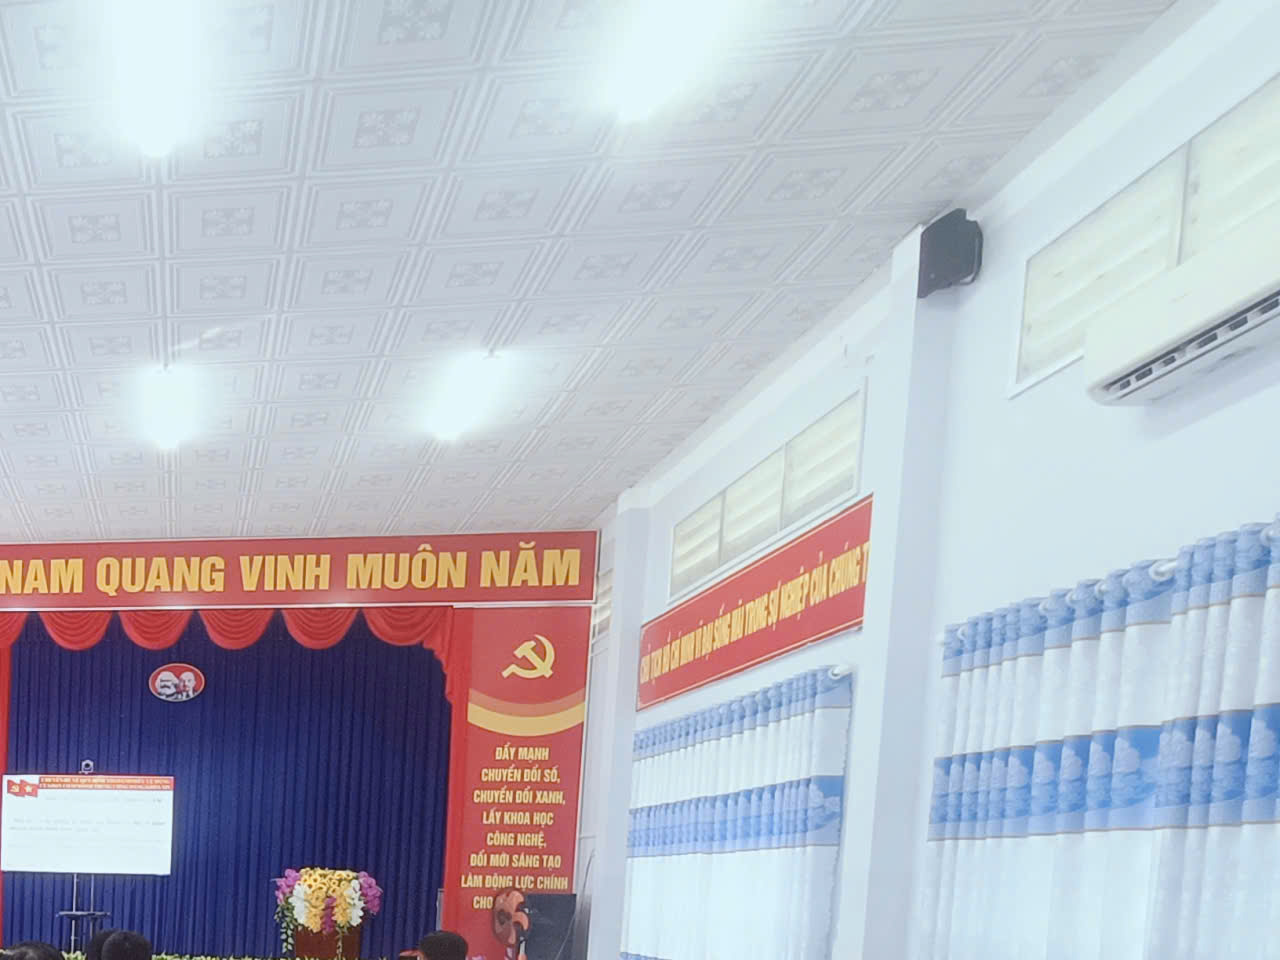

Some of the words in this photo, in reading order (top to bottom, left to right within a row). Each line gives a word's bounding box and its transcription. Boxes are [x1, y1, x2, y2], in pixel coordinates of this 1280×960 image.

[96, 556, 225, 597] QUANG
[239, 554, 330, 592] VINH
[346, 543, 467, 589] MUÔN
[479, 541, 581, 588] NĂM
[809, 551, 829, 606] CỦA
[828, 541, 862, 598] CHÚNG
[517, 746, 550, 764] MẠNH
[481, 763, 522, 782] CHUYỂN
[523, 763, 542, 782] ĐỔI
[543, 764, 561, 784] SỐ,
[473, 784, 514, 803] CHUYỂN
[515, 785, 534, 803] ĐỔI
[535, 790, 566, 806] XANH,
[482, 806, 502, 825] LẤY
[503, 811, 531, 825] KHOA
[532, 811, 554, 829] HỌC
[486, 830, 516, 847] CÔNG
[470, 849, 488, 867] ĐỔI
[489, 852, 510, 868] MỚI
[511, 852, 540, 869] SÁNG
[542, 854, 562, 872] TẠO
[461, 872, 483, 888] LÀM
[485, 873, 513, 891] ĐỘNG
[515, 875, 535, 892] LỰC
[536, 874, 569, 890] CHÍNH
[472, 896, 494, 910] CHO
